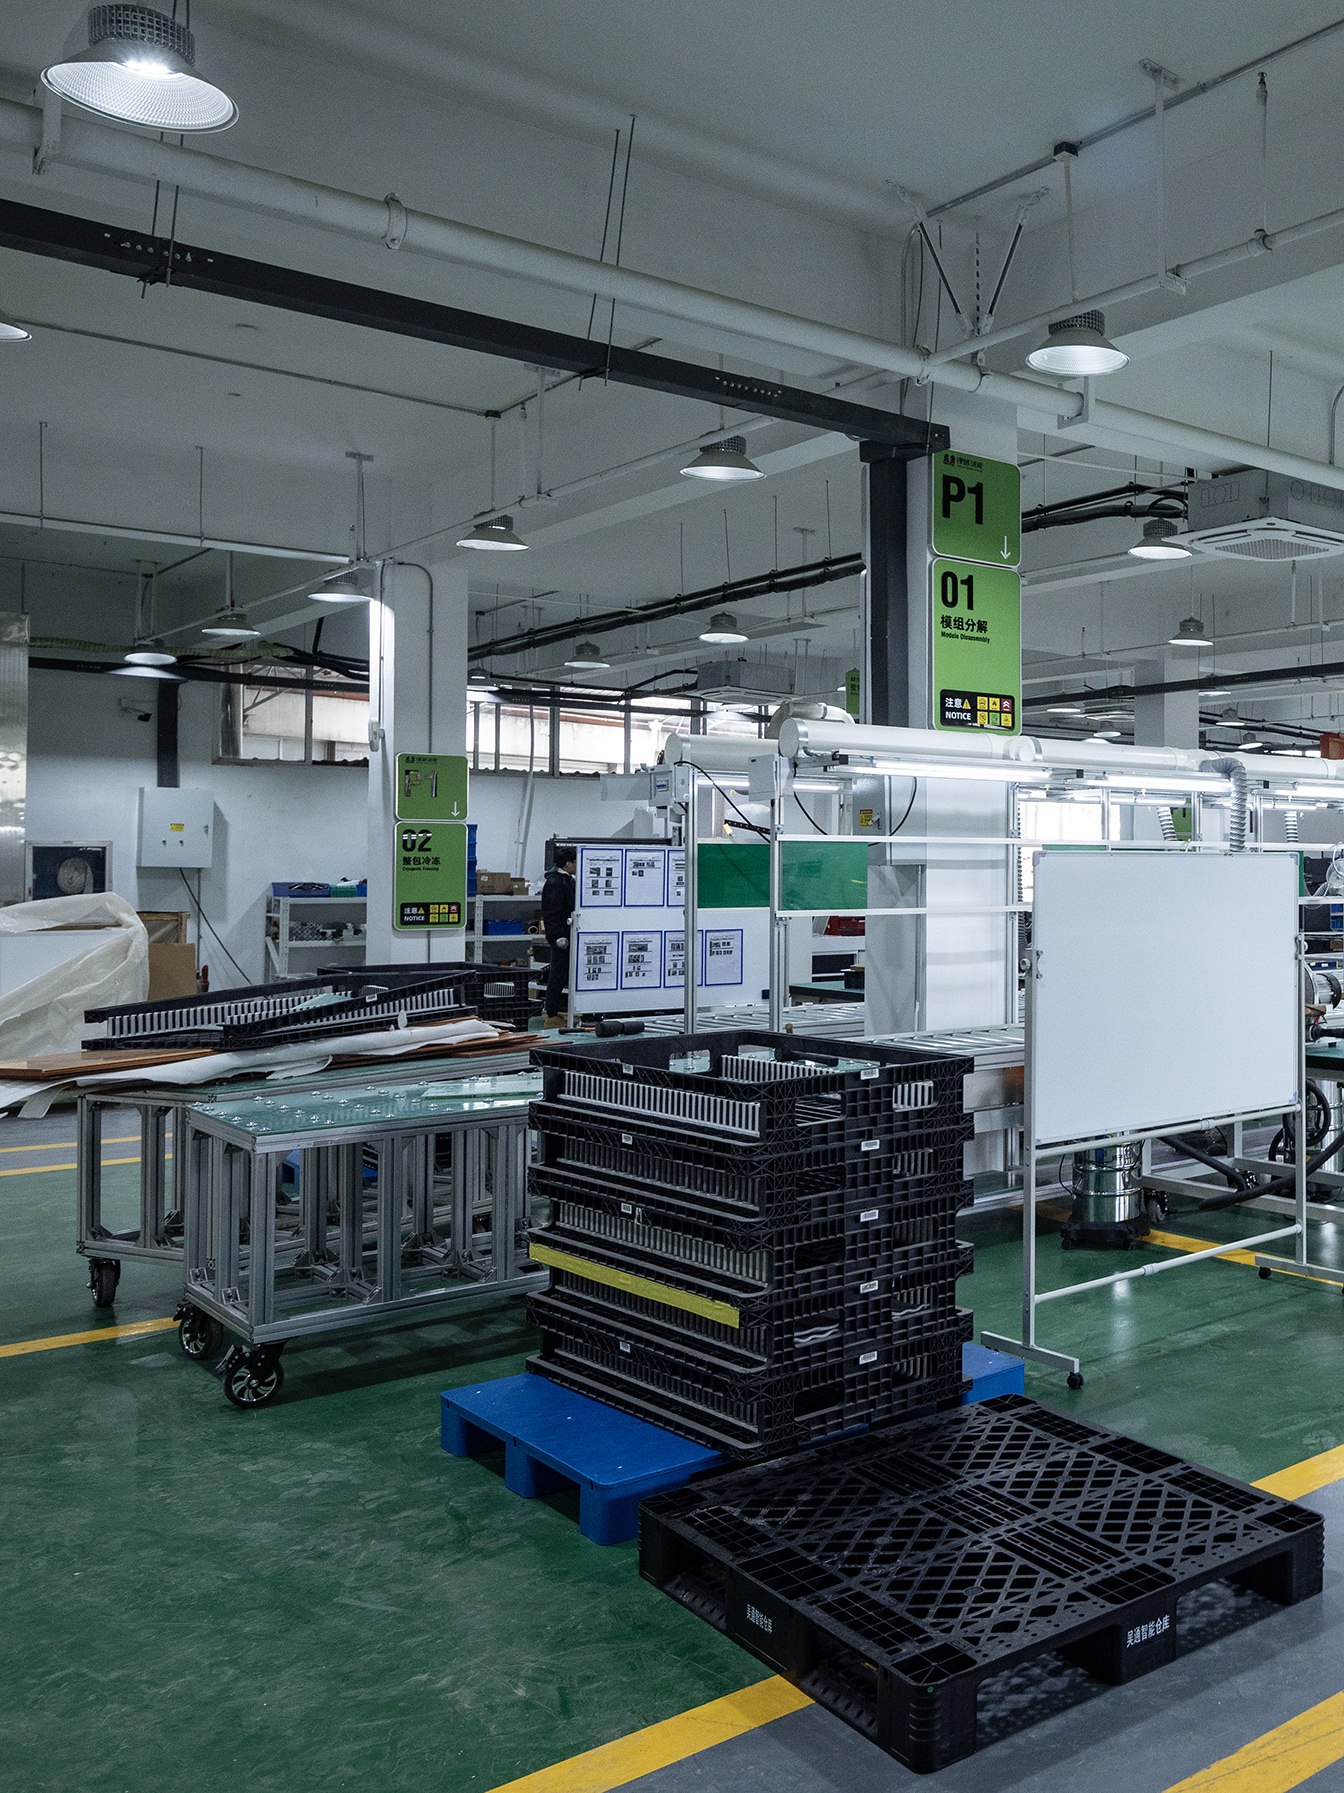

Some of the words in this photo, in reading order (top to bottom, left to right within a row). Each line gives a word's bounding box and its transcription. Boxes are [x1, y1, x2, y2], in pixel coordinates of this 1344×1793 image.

[942, 474, 983, 525] P1
[941, 571, 974, 611] 01
[940, 614, 988, 634] 模组分解
[941, 631, 959, 640] Module
[960, 633, 990, 644] Disassembly
[945, 697, 963, 709] 注意
[945, 711, 971, 721] NOTICE
[404, 769, 437, 797] P1
[402, 829, 432, 852] 02
[403, 856, 441, 865] 整包冷冻
[1126, 1614, 1170, 1648] 吴通智能仓库
